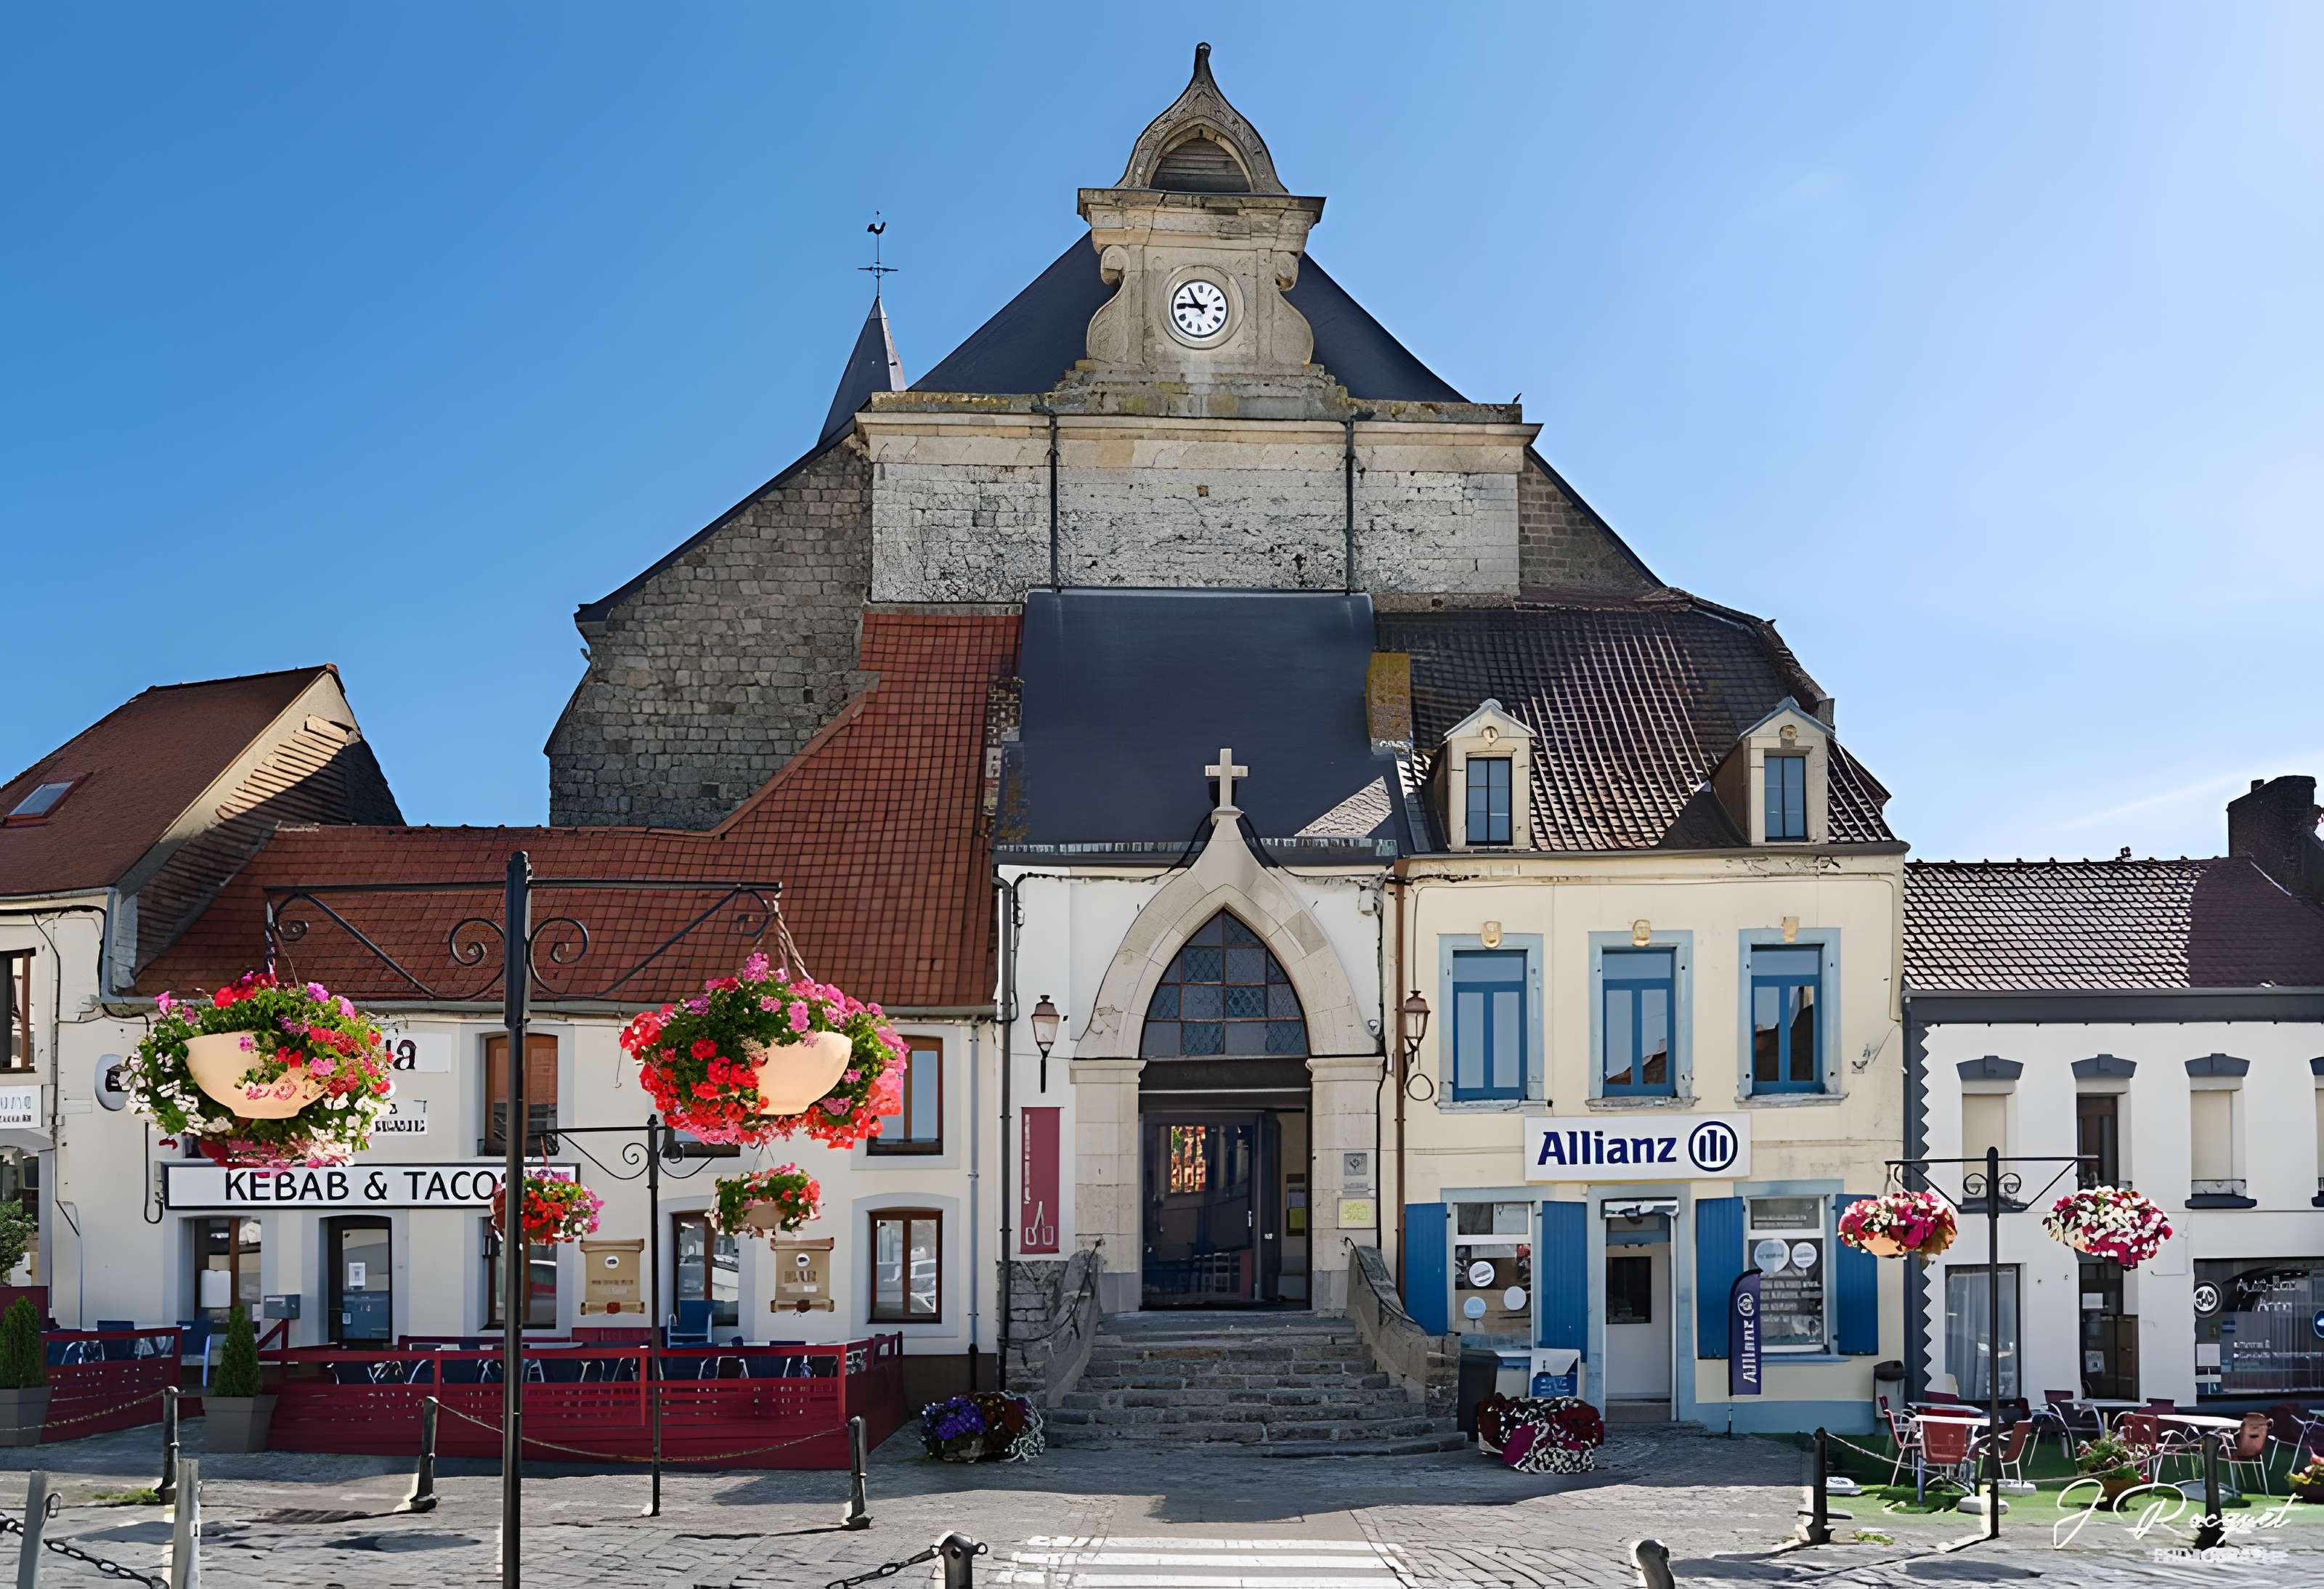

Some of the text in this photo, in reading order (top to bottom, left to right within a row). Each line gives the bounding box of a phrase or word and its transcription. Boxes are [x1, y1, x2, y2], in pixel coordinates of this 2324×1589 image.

[1537, 1130, 1677, 1166] Allianz
[225, 1170, 507, 1200] KEBAB & TACO
